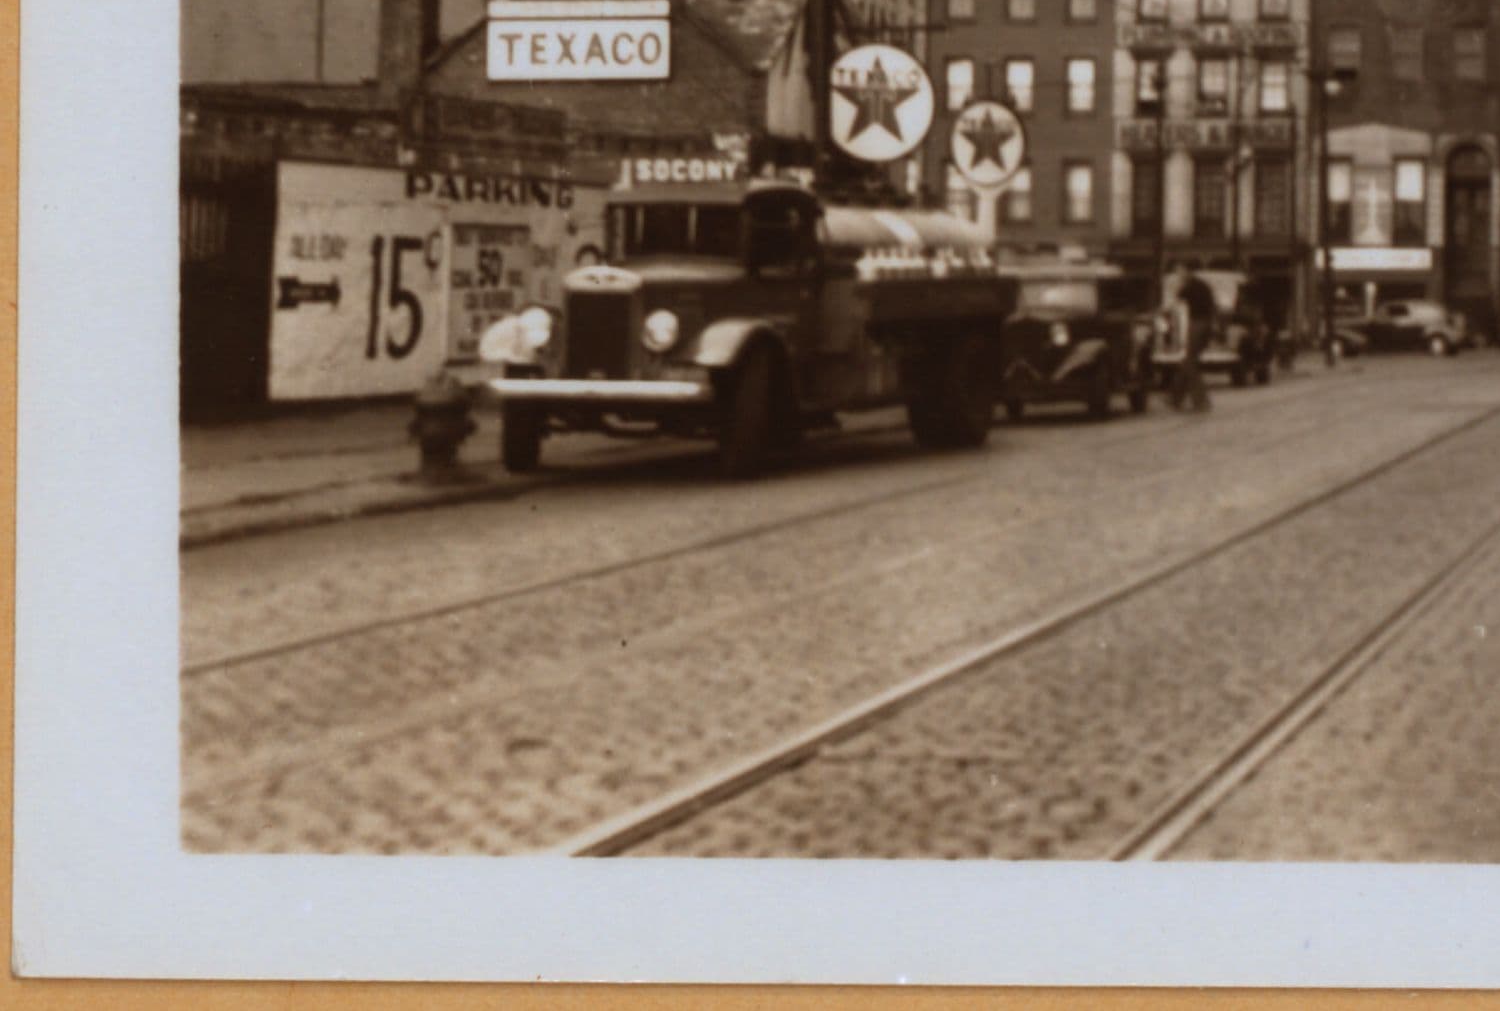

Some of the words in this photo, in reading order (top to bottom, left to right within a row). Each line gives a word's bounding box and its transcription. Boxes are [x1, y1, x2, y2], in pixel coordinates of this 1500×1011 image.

[499, 31, 662, 66] TEXACO
[636, 157, 737, 182] SOCONY
[405, 171, 574, 210] PARKING
